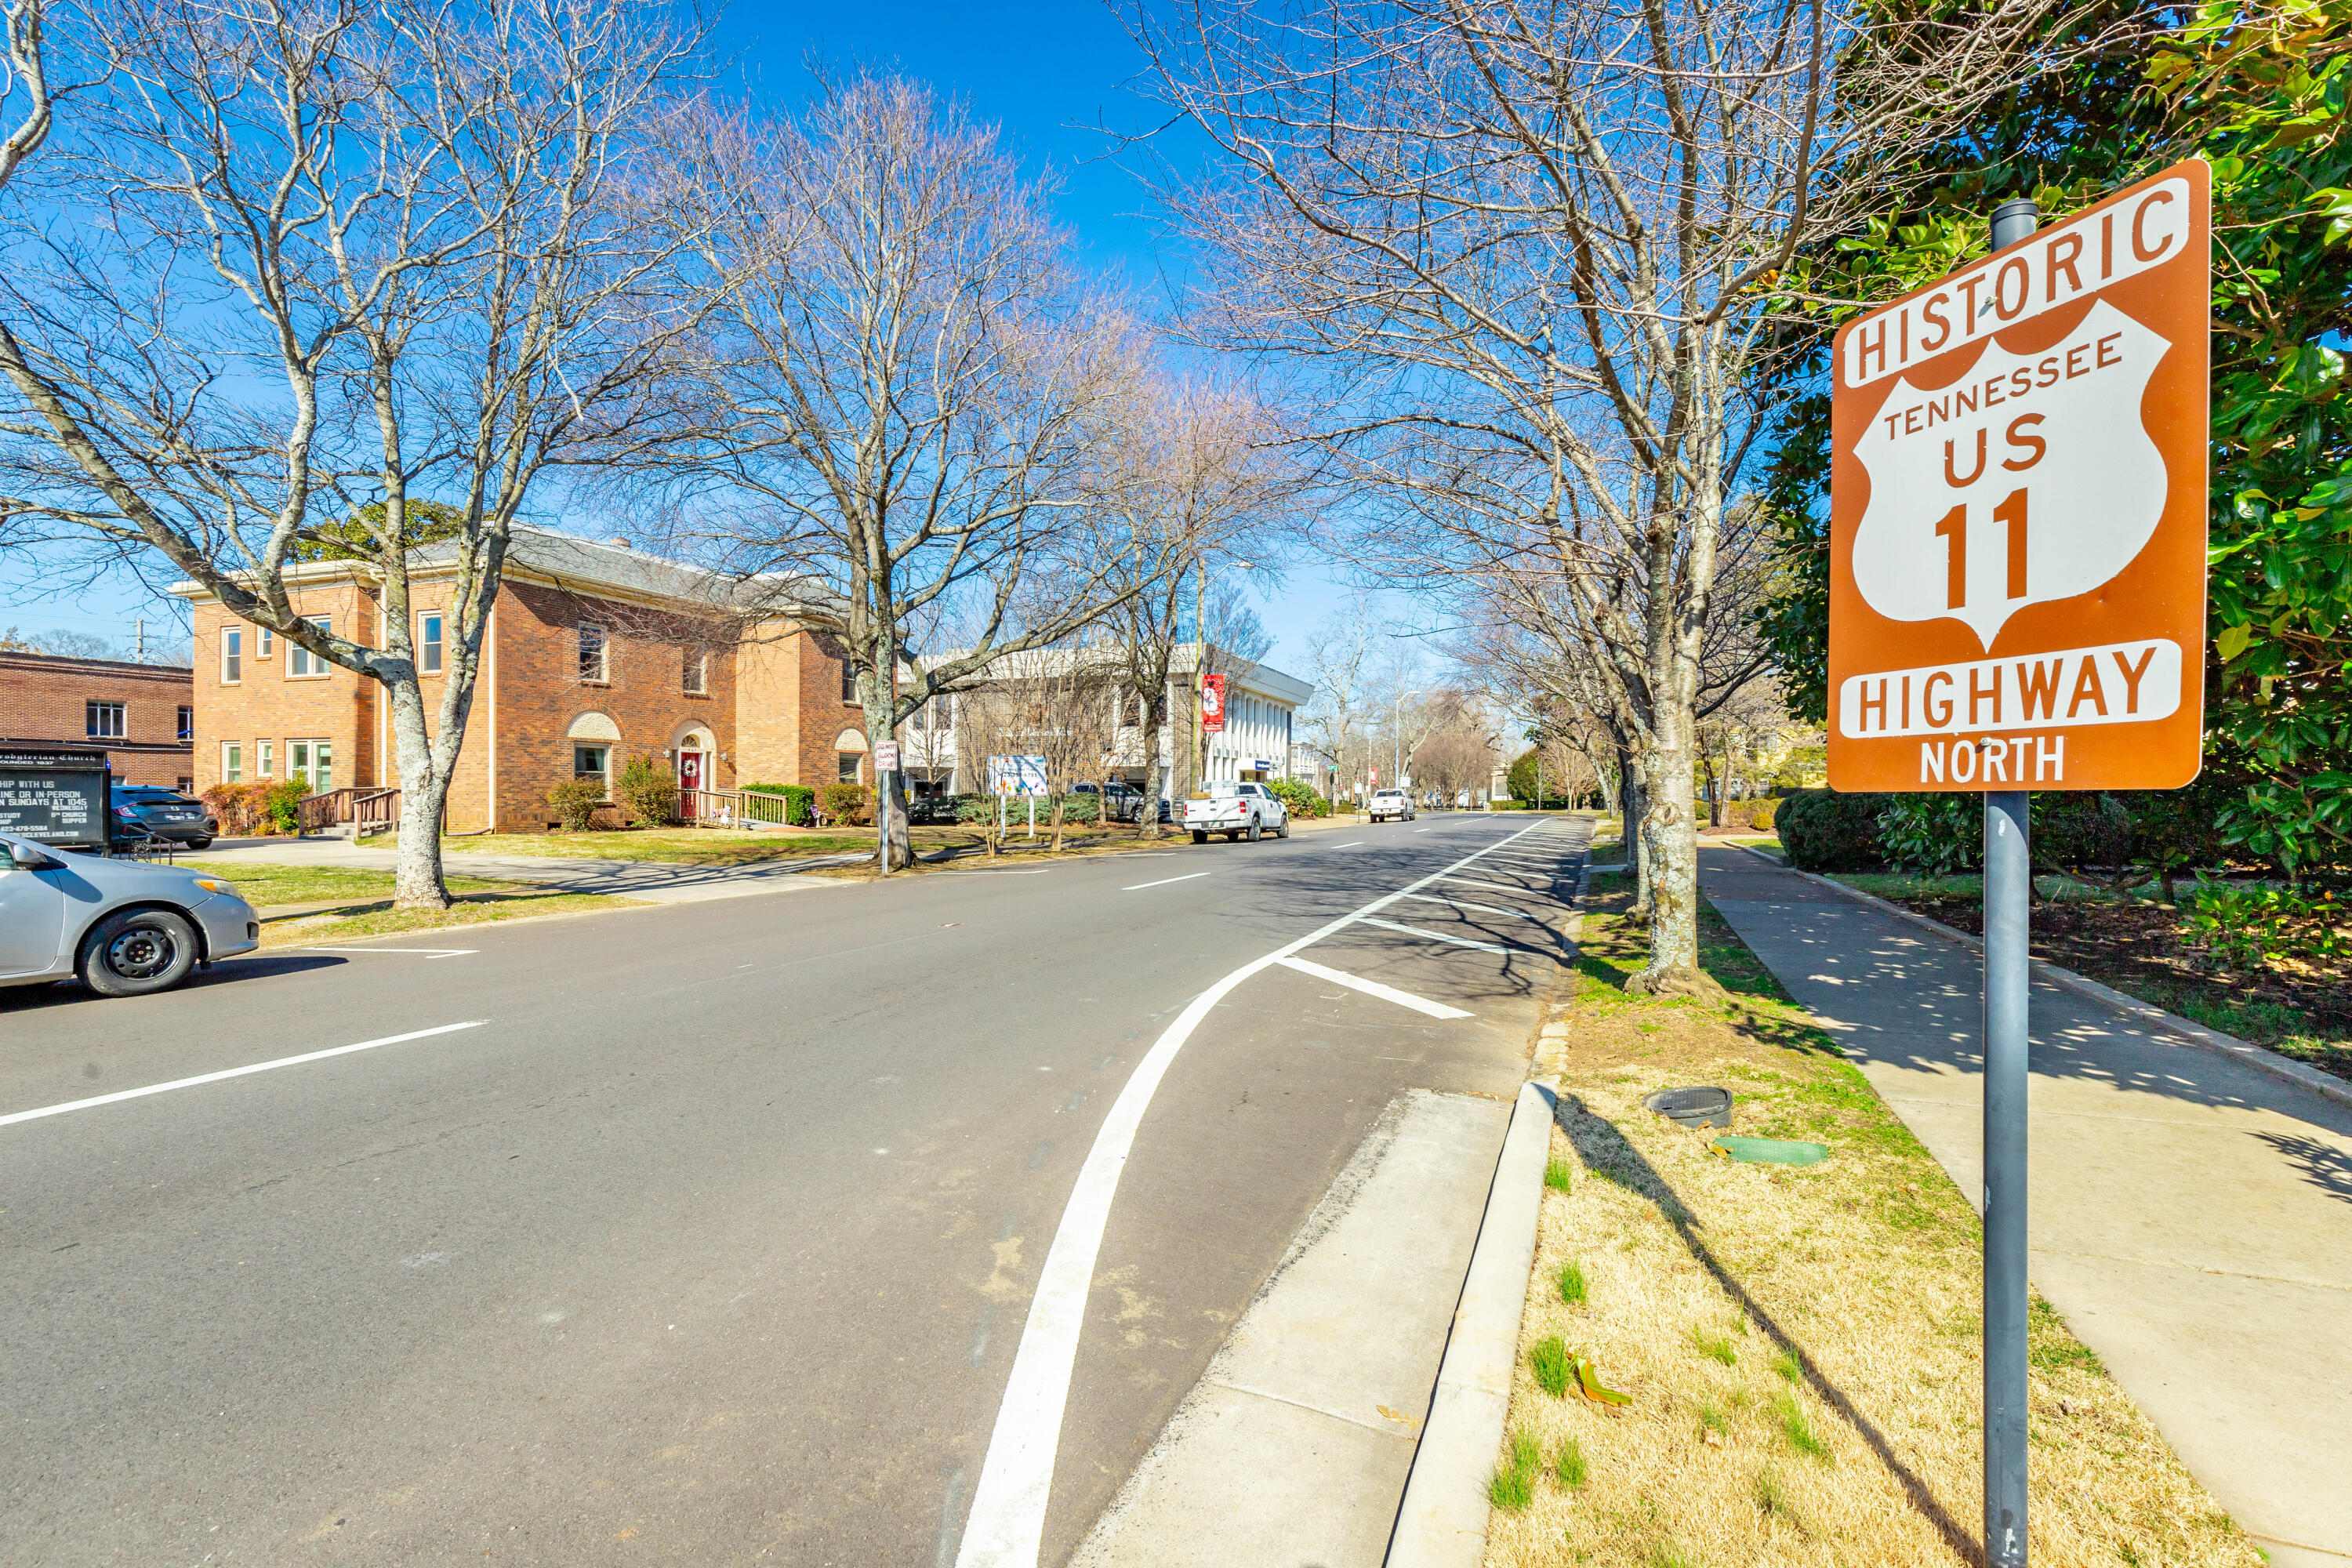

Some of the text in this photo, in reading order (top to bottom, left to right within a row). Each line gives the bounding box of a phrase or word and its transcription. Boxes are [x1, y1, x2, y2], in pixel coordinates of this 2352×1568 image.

[1859, 189, 2174, 380] HISTORIC
[1884, 332, 2122, 441] TENNESSEE
[1944, 412, 2046, 488] US
[1935, 487, 2029, 610] 11
[1859, 647, 2158, 732] HIGHWAY
[19, 790, 31, 799] OR
[35, 790, 81, 799] IN-PERSON
[1921, 735, 2064, 783] NORTH
